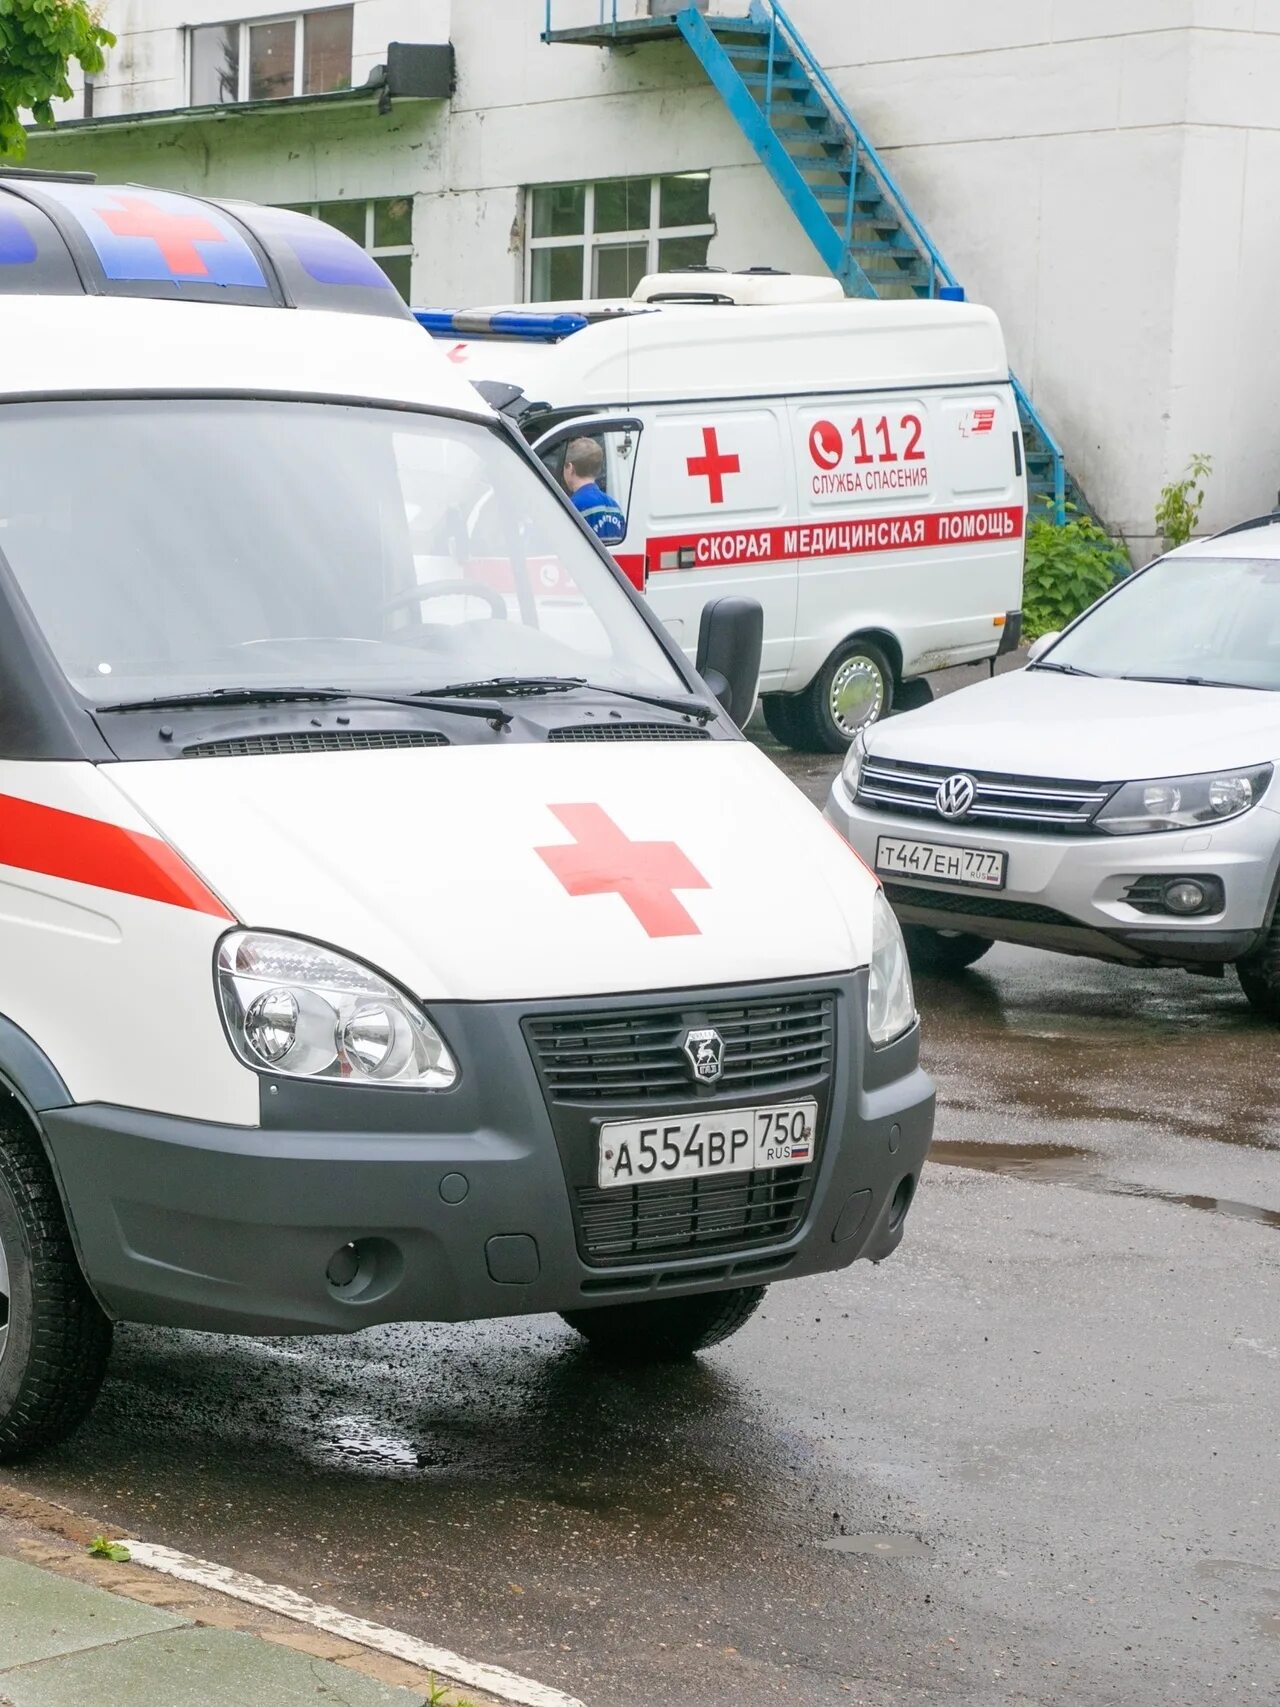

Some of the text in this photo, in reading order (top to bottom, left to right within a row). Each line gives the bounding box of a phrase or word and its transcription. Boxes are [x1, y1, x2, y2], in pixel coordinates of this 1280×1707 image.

[850, 414, 926, 464] 112
[812, 467, 928, 495] СЛУЖБА СПАСЕНИЯ
[696, 511, 1014, 561] СКОРАЯ МЕДИЦИНСКАЯ ПОМОЩЬ
[964, 851, 997, 874] 777
[970, 871, 987, 880] RUS
[758, 1111, 806, 1148] 750
[766, 1146, 791, 1161] RUS
